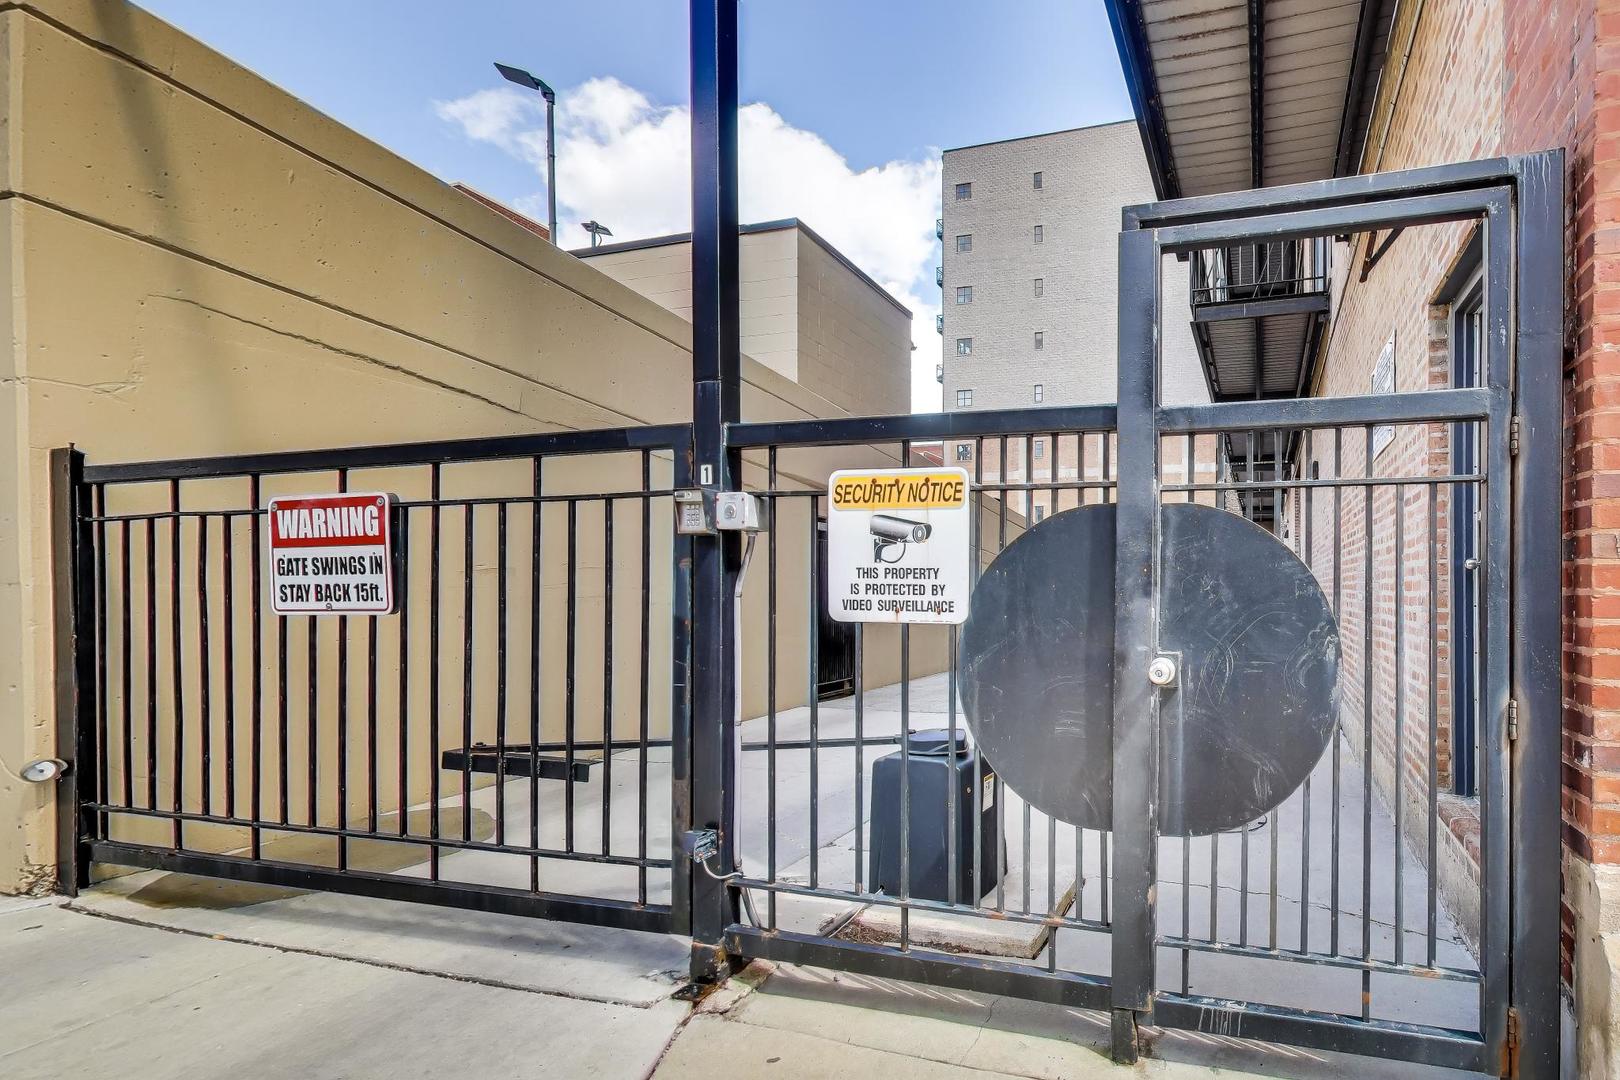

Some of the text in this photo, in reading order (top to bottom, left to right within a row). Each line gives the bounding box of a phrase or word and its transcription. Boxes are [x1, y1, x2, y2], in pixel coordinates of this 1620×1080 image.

[833, 482, 964, 504] SECURITY NOTICE
[277, 505, 379, 539] WARNING
[277, 555, 384, 576] GATE SWINGS IN
[856, 567, 940, 580] THIS PROPERTY
[280, 583, 384, 602] STAY BACK 15ft.
[850, 584, 946, 596] IS PROTECTED BY
[842, 599, 954, 613] VIDEO SURVEILLANCE
